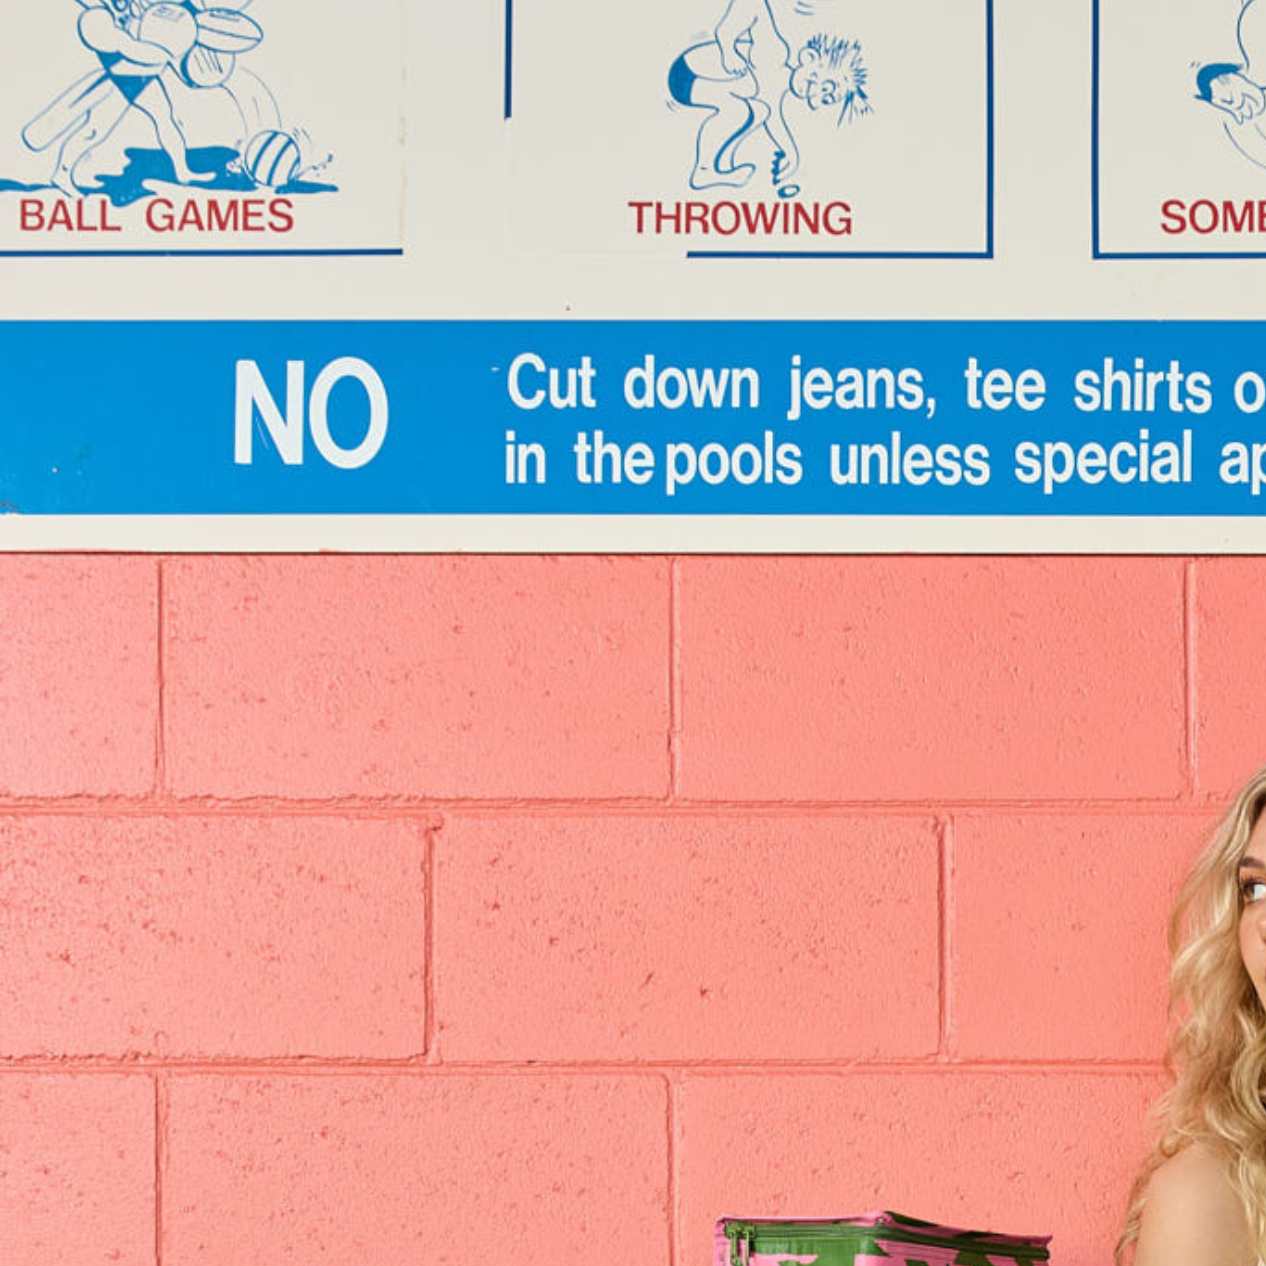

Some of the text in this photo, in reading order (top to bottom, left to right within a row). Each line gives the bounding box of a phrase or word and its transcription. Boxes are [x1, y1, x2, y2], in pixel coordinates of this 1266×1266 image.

[20, 198, 294, 233] BALL GAMES
[629, 201, 853, 236] THROWING
[234, 356, 390, 469] NO
[507, 352, 597, 411] Cut
[623, 353, 760, 411] down
[786, 354, 937, 421] jeans,
[964, 357, 1047, 412] tee
[1074, 357, 1213, 415] shirts
[505, 430, 547, 485] in
[573, 429, 656, 486] the
[666, 430, 804, 497] pools
[830, 430, 992, 487] unless
[1014, 428, 1193, 496] special
